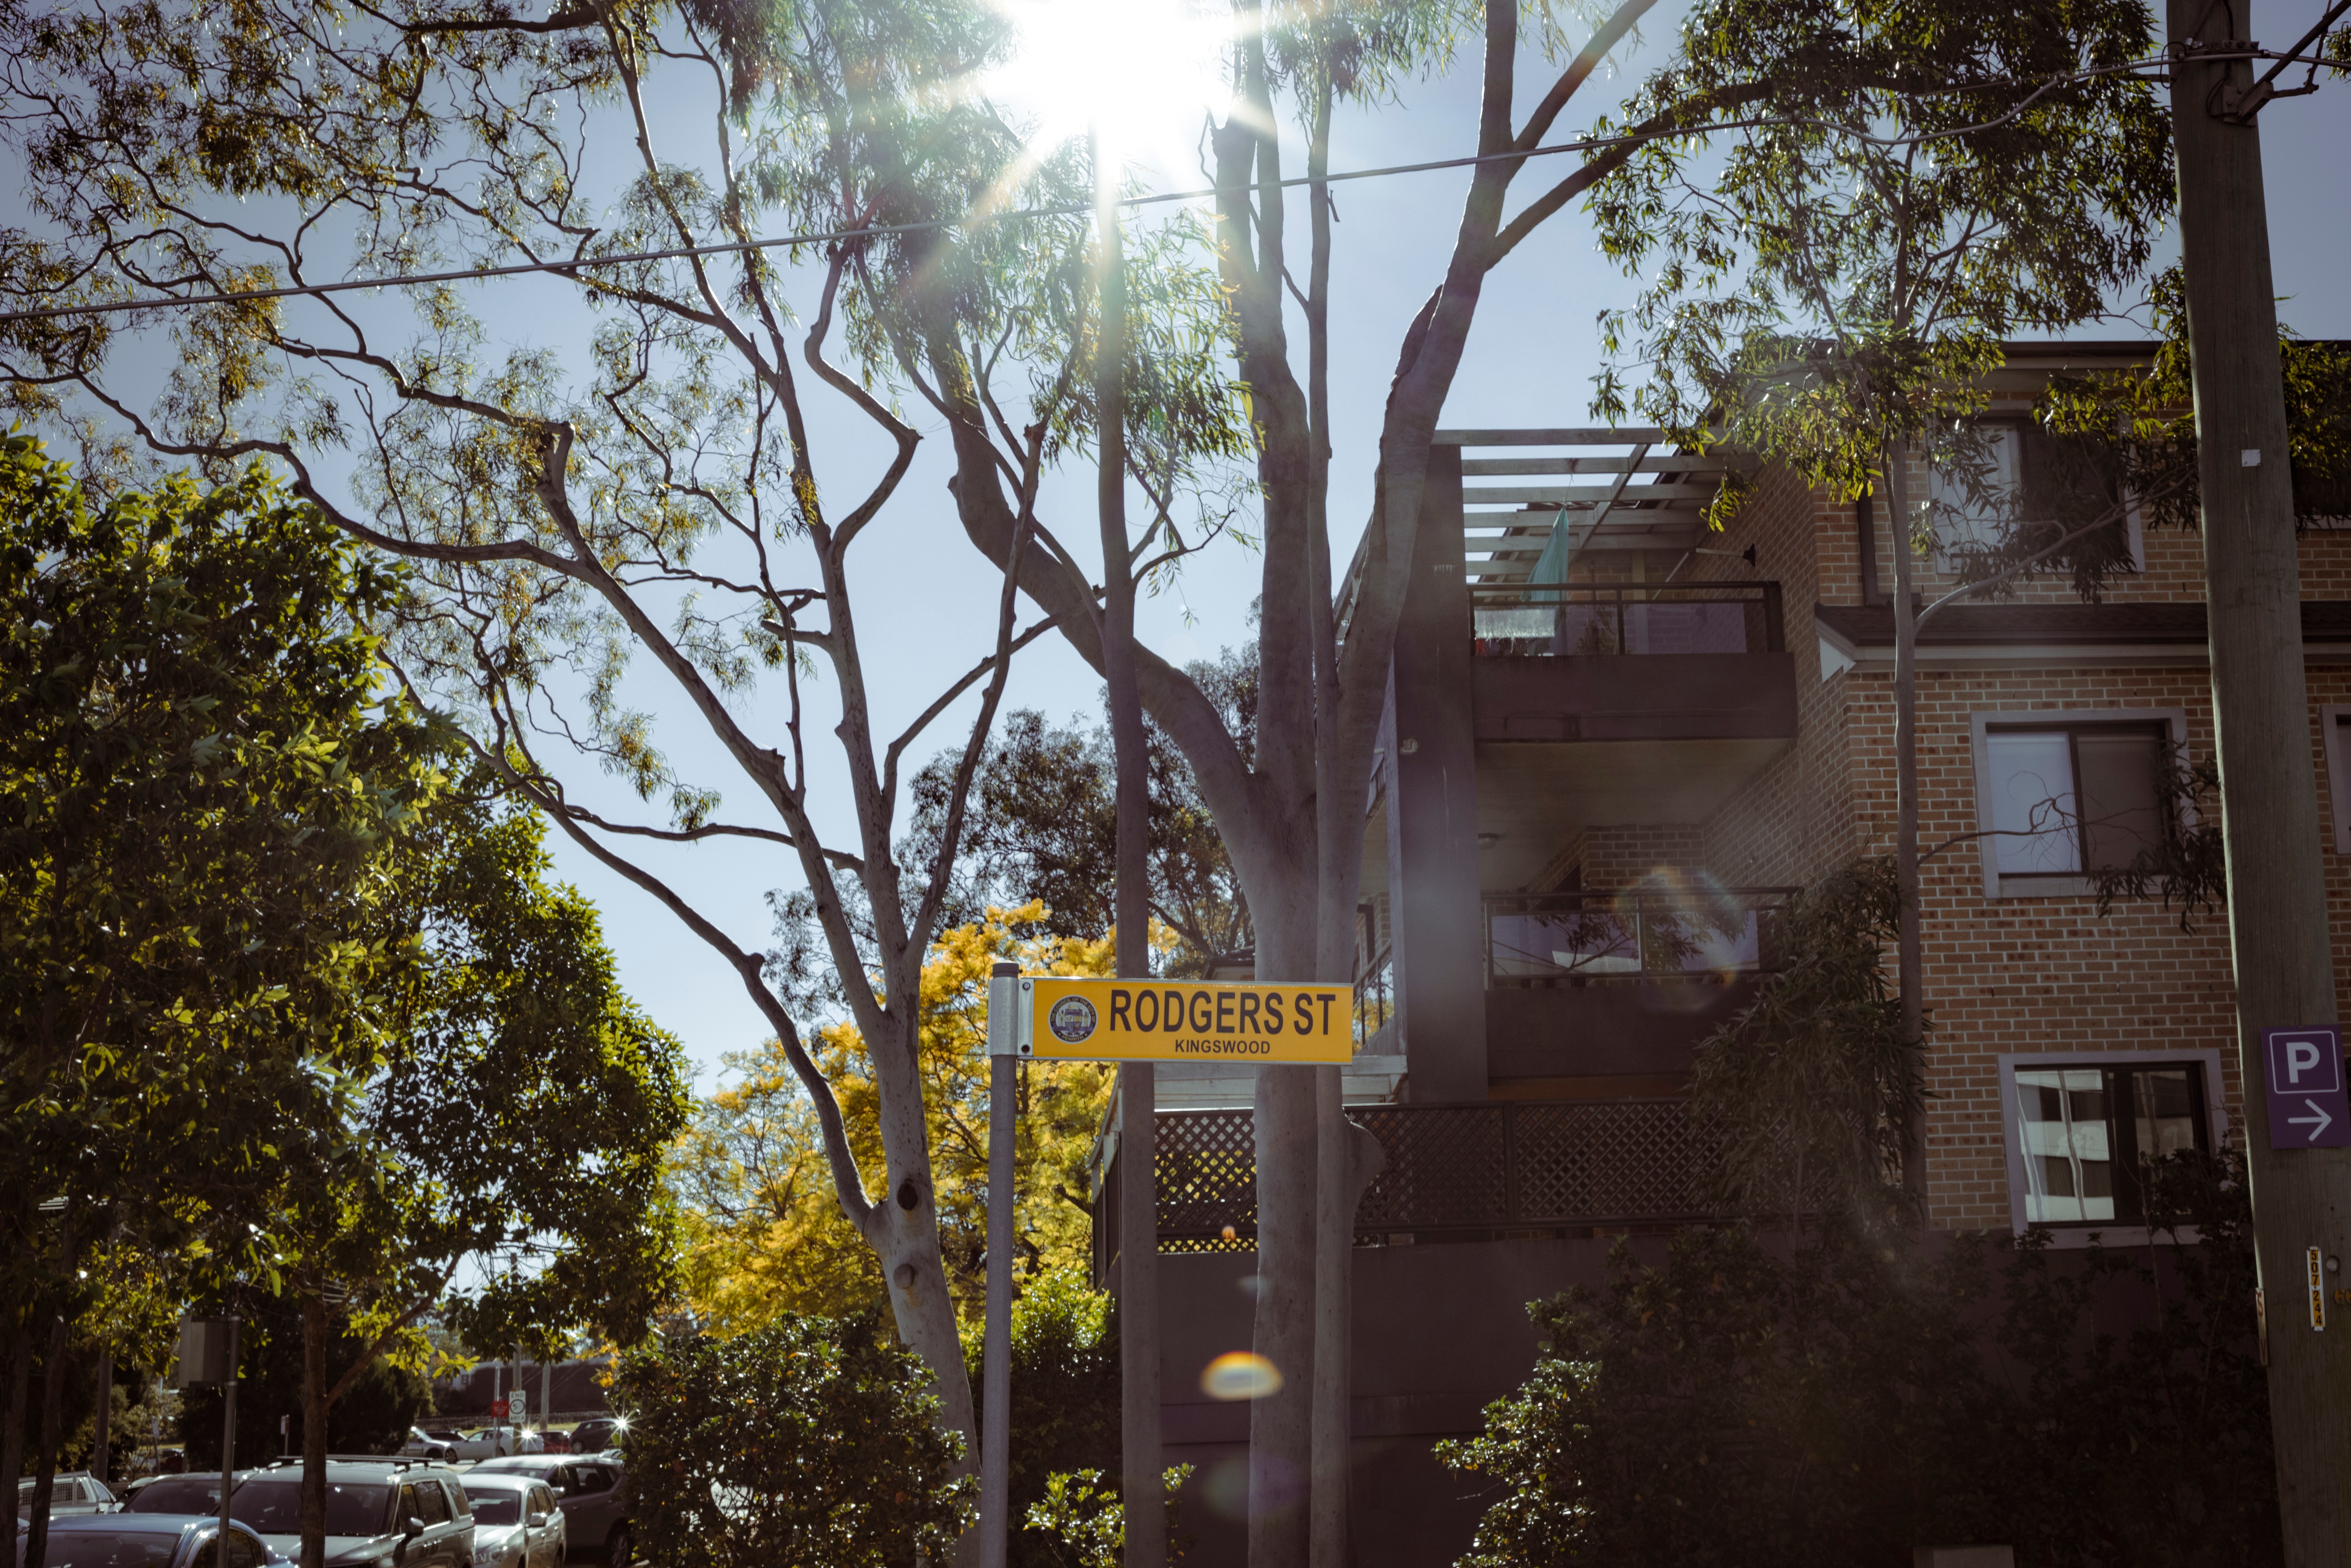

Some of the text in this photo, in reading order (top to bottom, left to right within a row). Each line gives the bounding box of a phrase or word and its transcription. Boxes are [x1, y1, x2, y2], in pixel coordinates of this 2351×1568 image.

[1054, 998, 1072, 1012] COUNCIL
[1110, 989, 1336, 1035] RODGERS ST
[1175, 1040, 1270, 1054] KINGSWOOD
[2286, 1042, 2320, 1083] P
